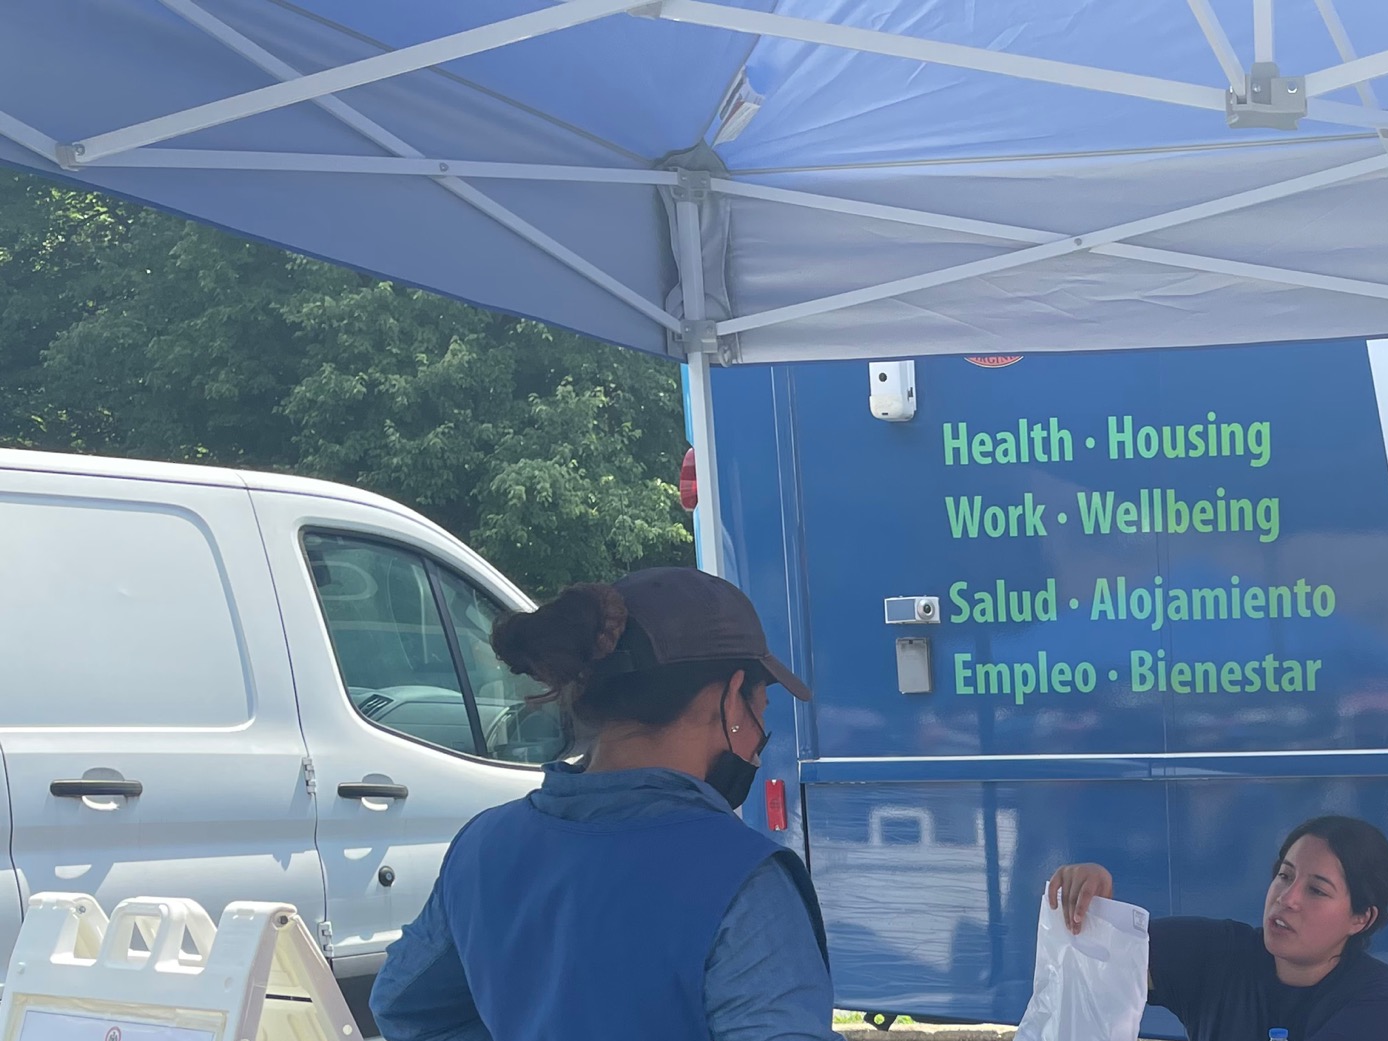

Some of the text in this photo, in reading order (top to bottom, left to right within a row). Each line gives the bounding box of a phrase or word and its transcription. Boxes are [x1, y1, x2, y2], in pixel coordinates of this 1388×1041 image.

[942, 411, 1272, 468] Health Housing
[945, 487, 1280, 543] Work Wellbeing
[948, 575, 1336, 631] Salud Alojamiento
[953, 649, 1322, 705] Empleo Bienestar
